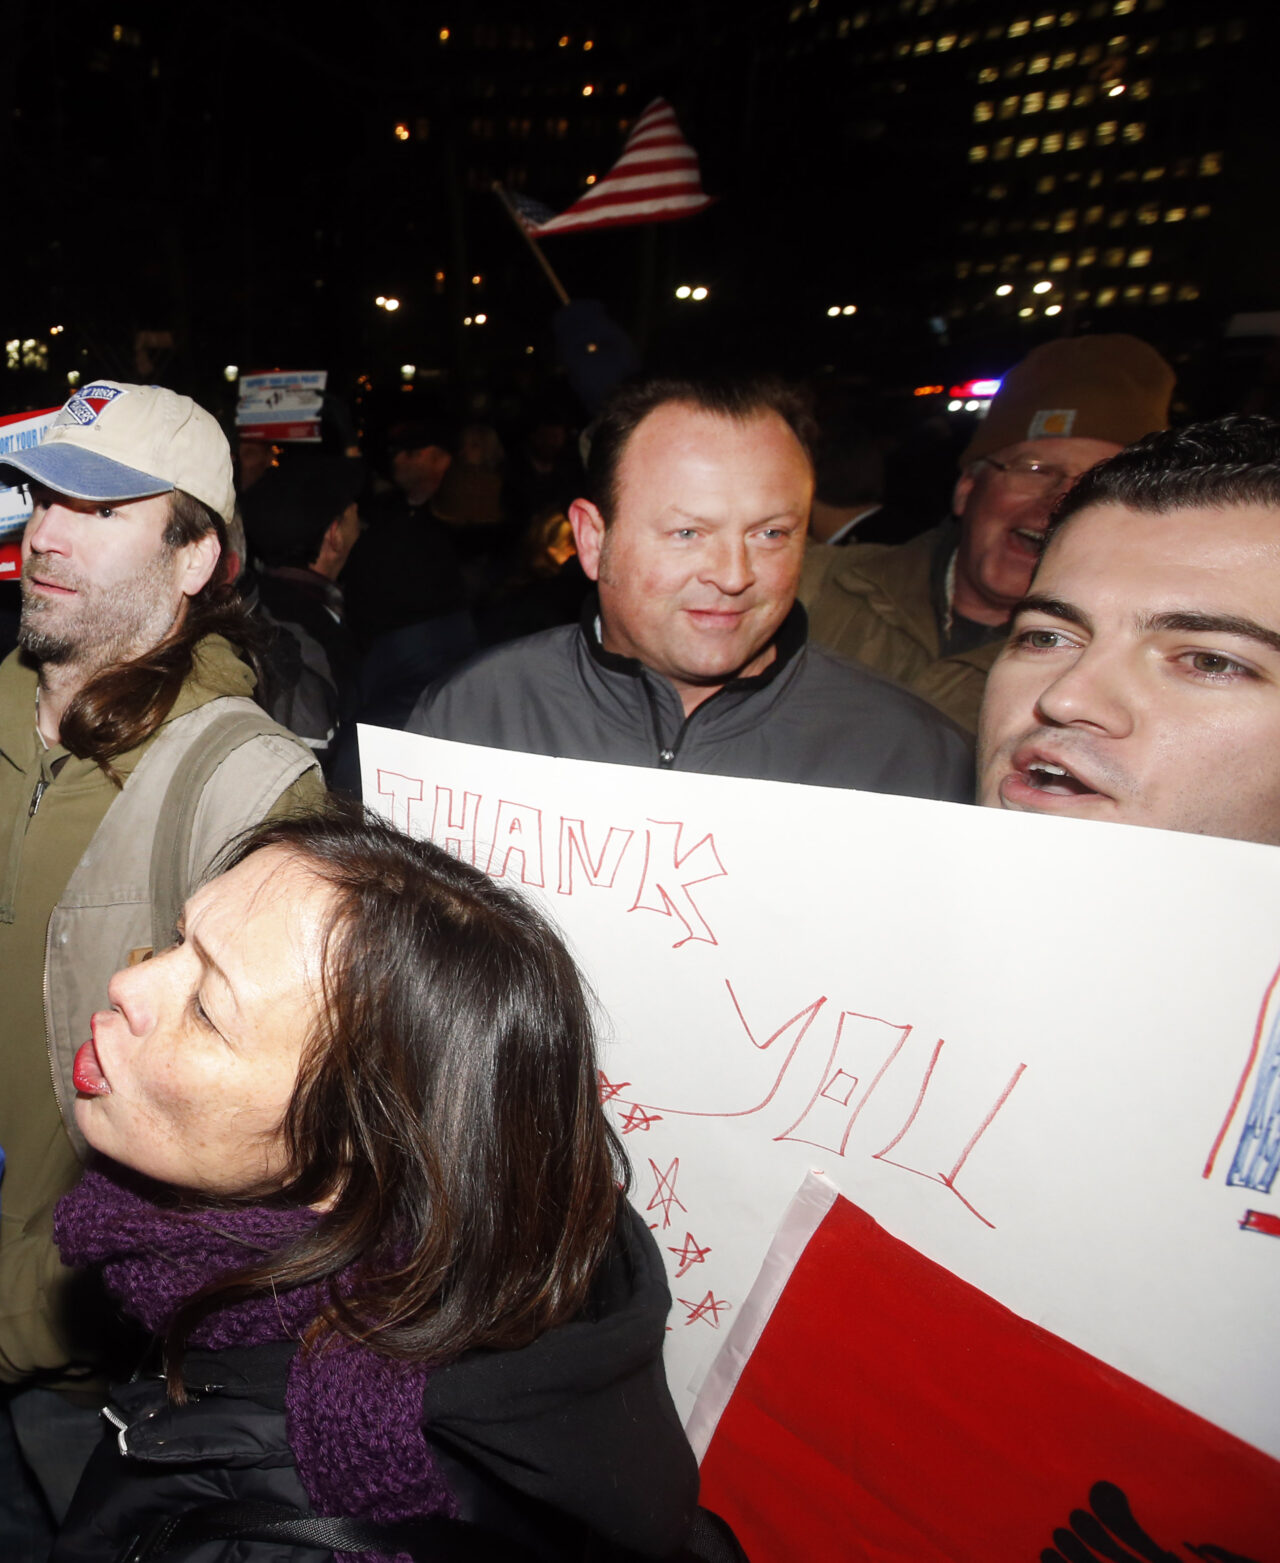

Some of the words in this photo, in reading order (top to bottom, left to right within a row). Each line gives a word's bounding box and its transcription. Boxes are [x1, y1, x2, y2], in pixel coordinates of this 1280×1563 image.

[15, 428, 38, 450] YOUR
[376, 768, 729, 949] THANK
[620, 977, 1029, 1229] YOU
